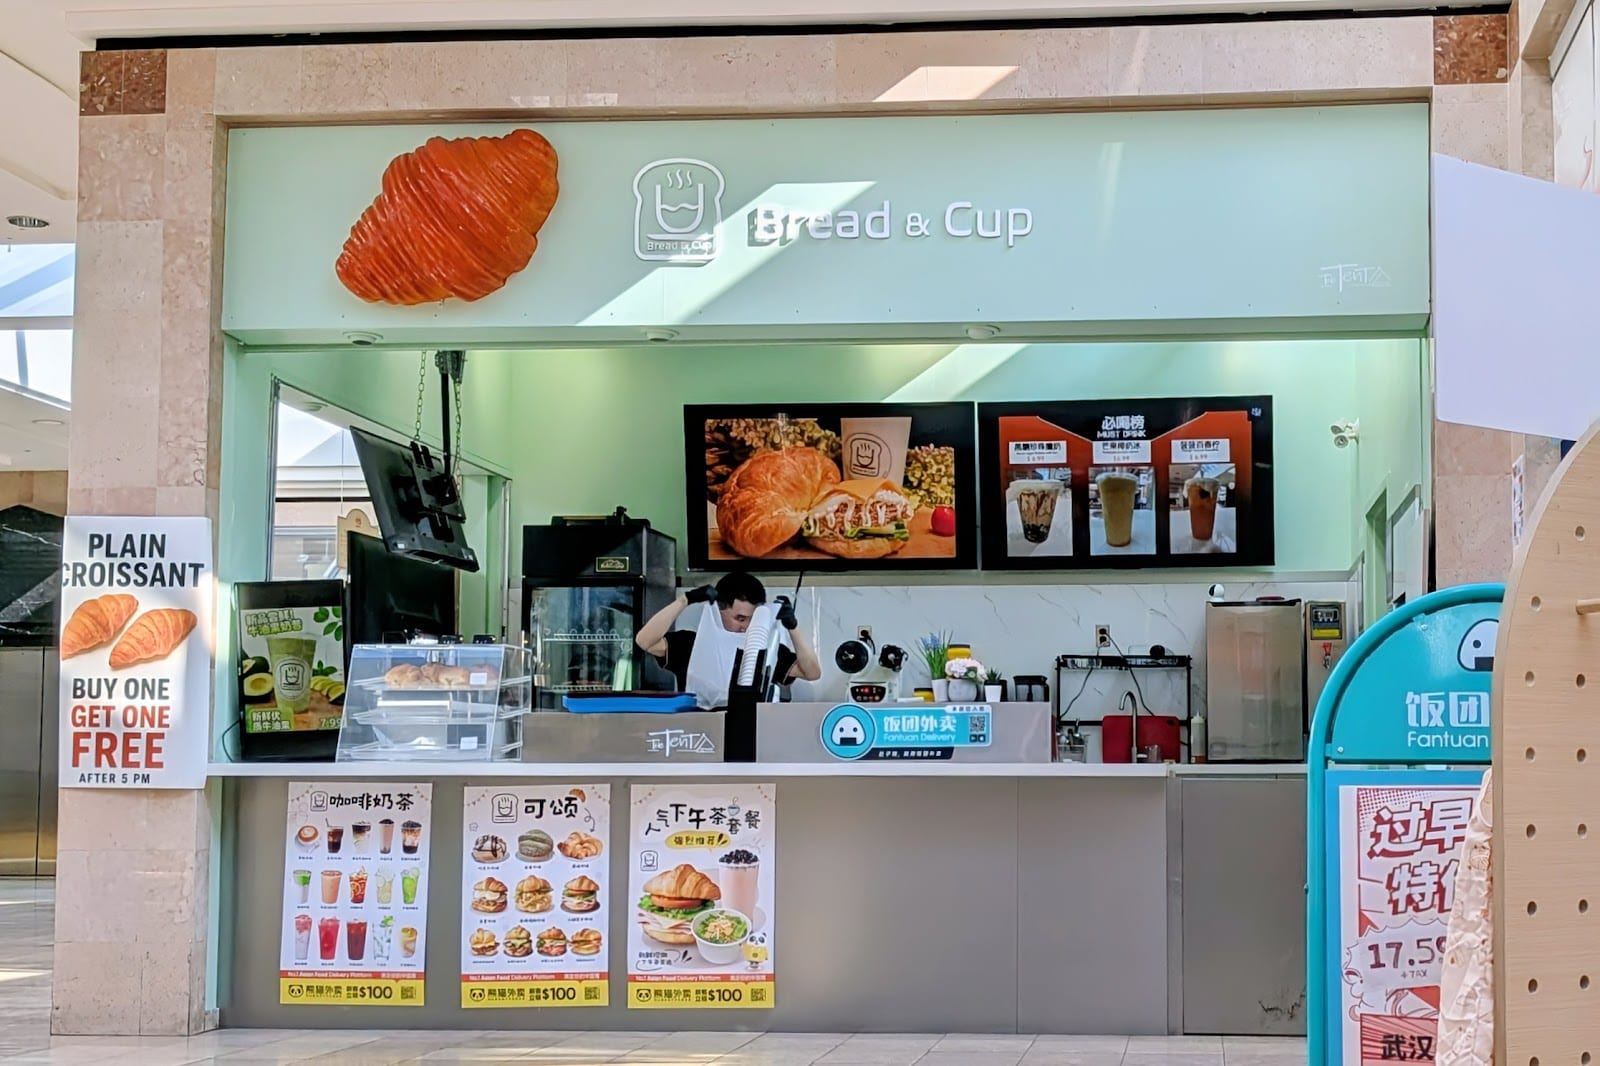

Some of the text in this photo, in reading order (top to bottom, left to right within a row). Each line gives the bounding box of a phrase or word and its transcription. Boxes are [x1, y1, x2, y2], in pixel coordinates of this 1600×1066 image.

[754, 200, 1034, 247] Bread & Cup
[647, 241, 678, 251] Bread
[1096, 430, 1120, 439] MUST
[88, 533, 167, 558] PLAIN
[62, 562, 205, 587] CROISSANT
[72, 678, 170, 700] BUY ONE
[71, 705, 170, 728] GET ONE
[1405, 691, 1490, 728] 饭团
[883, 715, 957, 732] 饭团外卖
[884, 733, 956, 743] Fantuan Delivery
[1407, 730, 1489, 748] Fantuan
[71, 731, 165, 769] FREE
[79, 773, 151, 784] AFTER 5 PM
[329, 792, 415, 811] 咖啡奶茶
[524, 796, 578, 819] 可颂
[645, 803, 761, 835] 人气下午茶套餐
[1368, 798, 1473, 859] 过早
[359, 985, 393, 999] $100
[542, 987, 576, 1000] $100
[708, 988, 743, 1002] $100
[1381, 1033, 1435, 1061] 武汉
